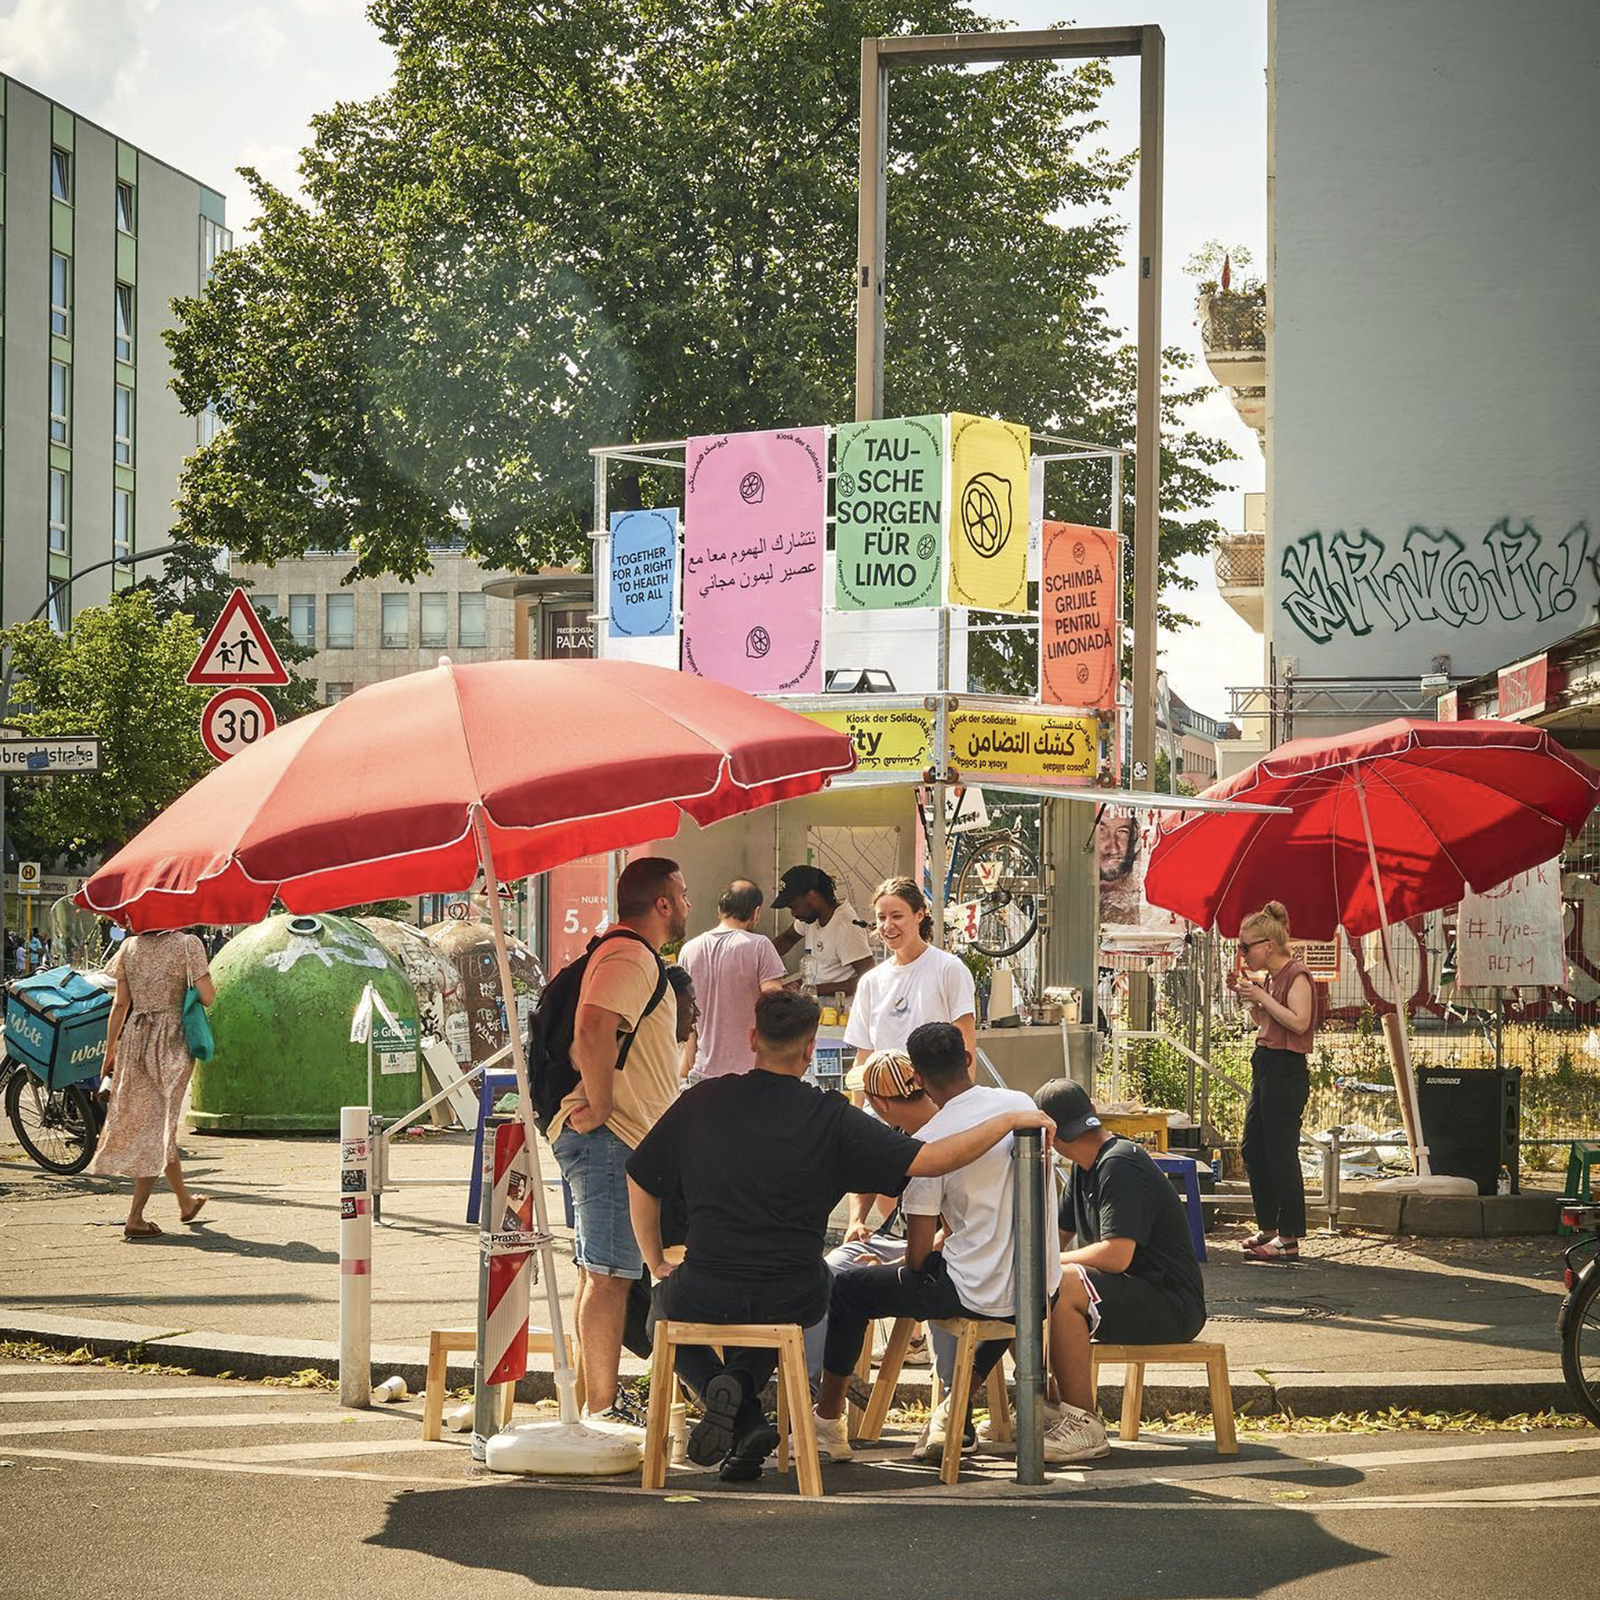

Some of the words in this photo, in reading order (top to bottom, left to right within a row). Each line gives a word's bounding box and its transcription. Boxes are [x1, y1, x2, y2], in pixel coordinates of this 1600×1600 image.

[795, 437, 804, 446] der
[805, 444, 822, 483] Solidarität
[864, 438, 920, 462] TAU-
[857, 469, 924, 493] SCHE
[837, 501, 941, 524] SORGEN
[772, 531, 816, 554] نتشارك
[864, 526, 910, 555] FÜR
[617, 547, 666, 566] TOGETHER
[707, 549, 726, 562] معا
[731, 538, 766, 566] الهموم
[613, 568, 631, 581] FOR
[634, 566, 641, 577] A
[643, 559, 672, 574] RIGHT
[688, 556, 703, 573] مع
[779, 563, 816, 582] عصير
[855, 563, 917, 587] LIMO
[618, 581, 631, 593] TO
[633, 574, 668, 590] HEALTH
[700, 574, 735, 598] مجاني
[741, 564, 773, 588] ليمون
[1045, 564, 1102, 593] SCHIMBĂ
[626, 594, 644, 605] FOR
[647, 588, 663, 601] ALL
[1055, 591, 1097, 613] GRIJILE
[1055, 611, 1100, 635] PENTRU
[556, 635, 594, 648] PALAS
[1047, 628, 1112, 659] LIMONADĂ
[218, 709, 259, 744] 30
[846, 713, 870, 723] Kiosk
[872, 714, 888, 723] der
[950, 714, 967, 733] Kiosk
[969, 714, 980, 723] der
[981, 715, 1017, 726] Solidarität
[968, 730, 1029, 758] التضامن
[979, 760, 987, 769] of
[988, 760, 1007, 770] Kiosk
[42, 879, 68, 893] harmacy
[581, 896, 599, 904] NUR
[1489, 955, 1513, 973] ALT
[10, 1013, 42, 1047] Wolt
[491, 1232, 521, 1243] Praxis
